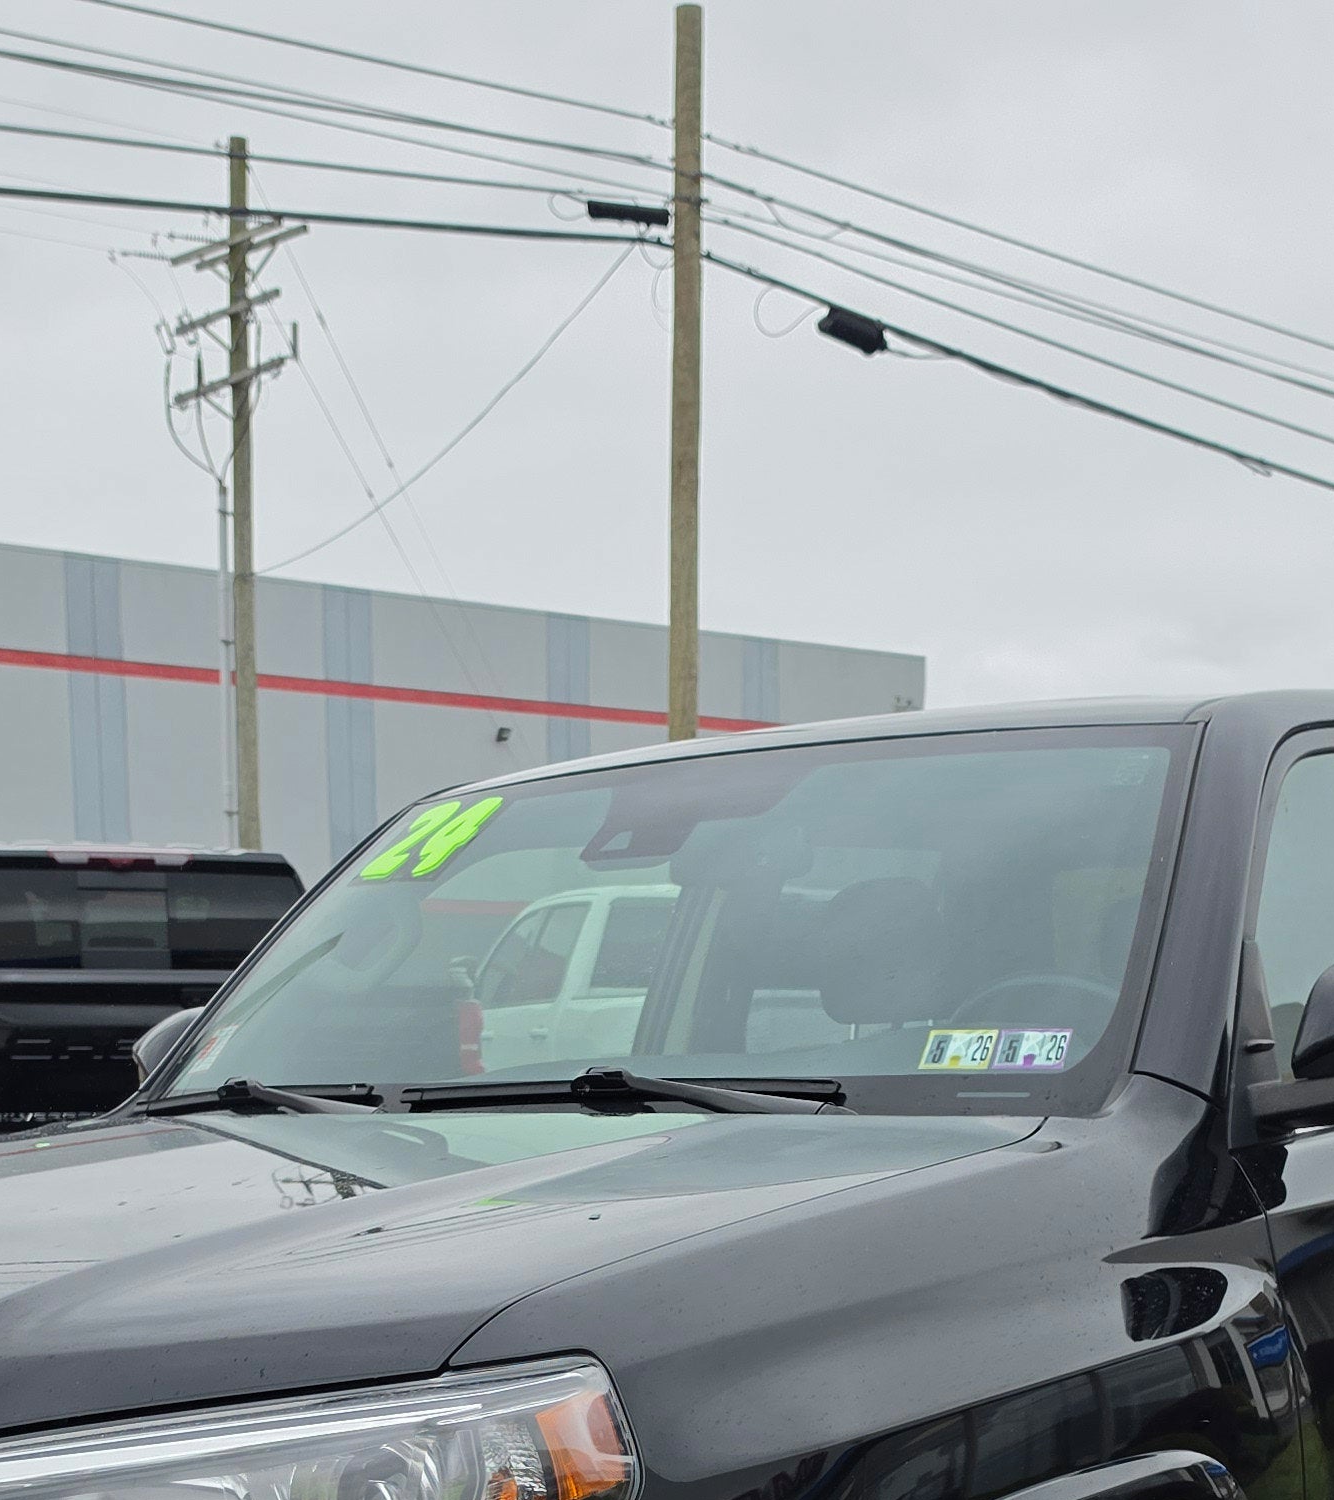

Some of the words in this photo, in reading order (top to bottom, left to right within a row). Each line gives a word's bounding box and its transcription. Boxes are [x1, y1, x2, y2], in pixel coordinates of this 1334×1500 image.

[360, 797, 503, 880] 24
[931, 1039, 947, 1063] 5
[970, 1035, 993, 1062] 26
[1005, 1039, 1019, 1063] 5
[1046, 1034, 1068, 1061] 26
